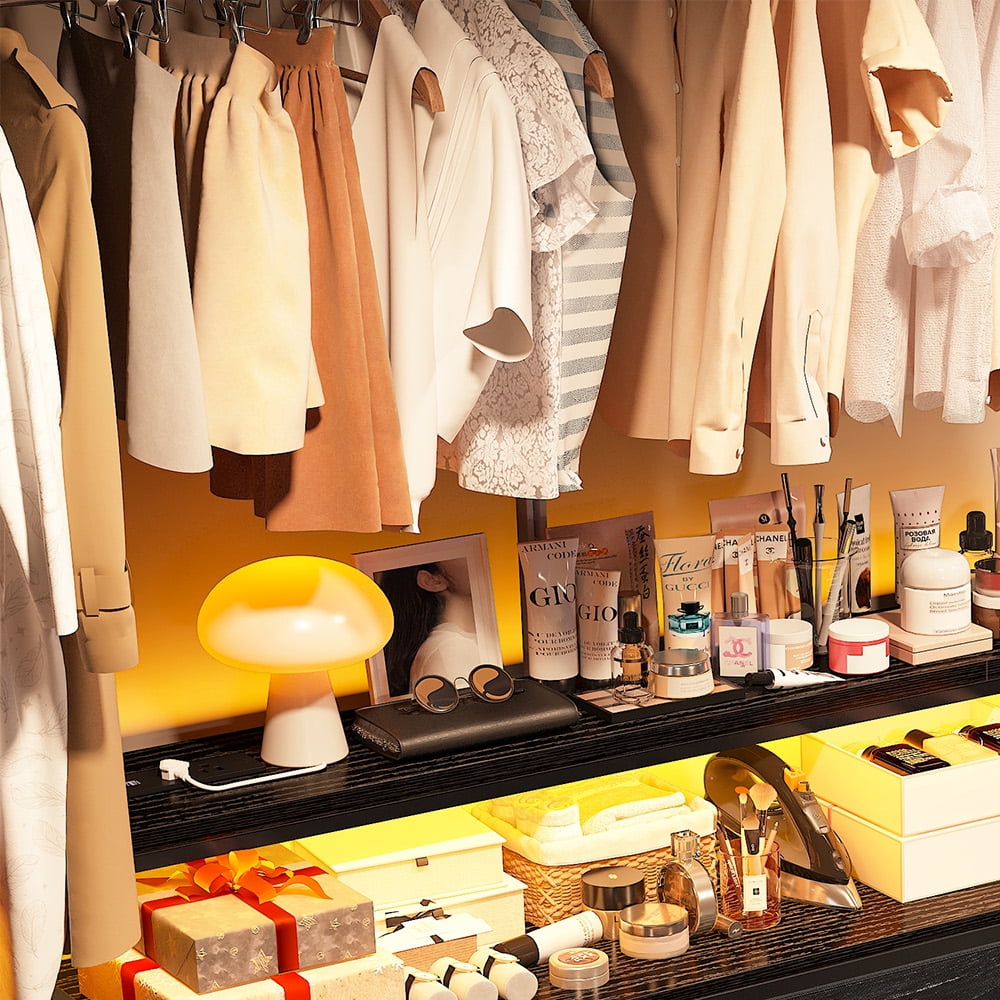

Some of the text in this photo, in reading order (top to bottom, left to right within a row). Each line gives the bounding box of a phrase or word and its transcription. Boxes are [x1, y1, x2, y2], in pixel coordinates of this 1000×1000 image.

[905, 529, 936, 537] РОЗОВАЯ
[521, 541, 566, 552] ARMANI
[547, 551, 577, 560] CODE
[660, 551, 715, 575] Flora
[665, 581, 710, 592] GUCCI
[530, 584, 576, 607] GIO
[578, 604, 618, 622] GIO
